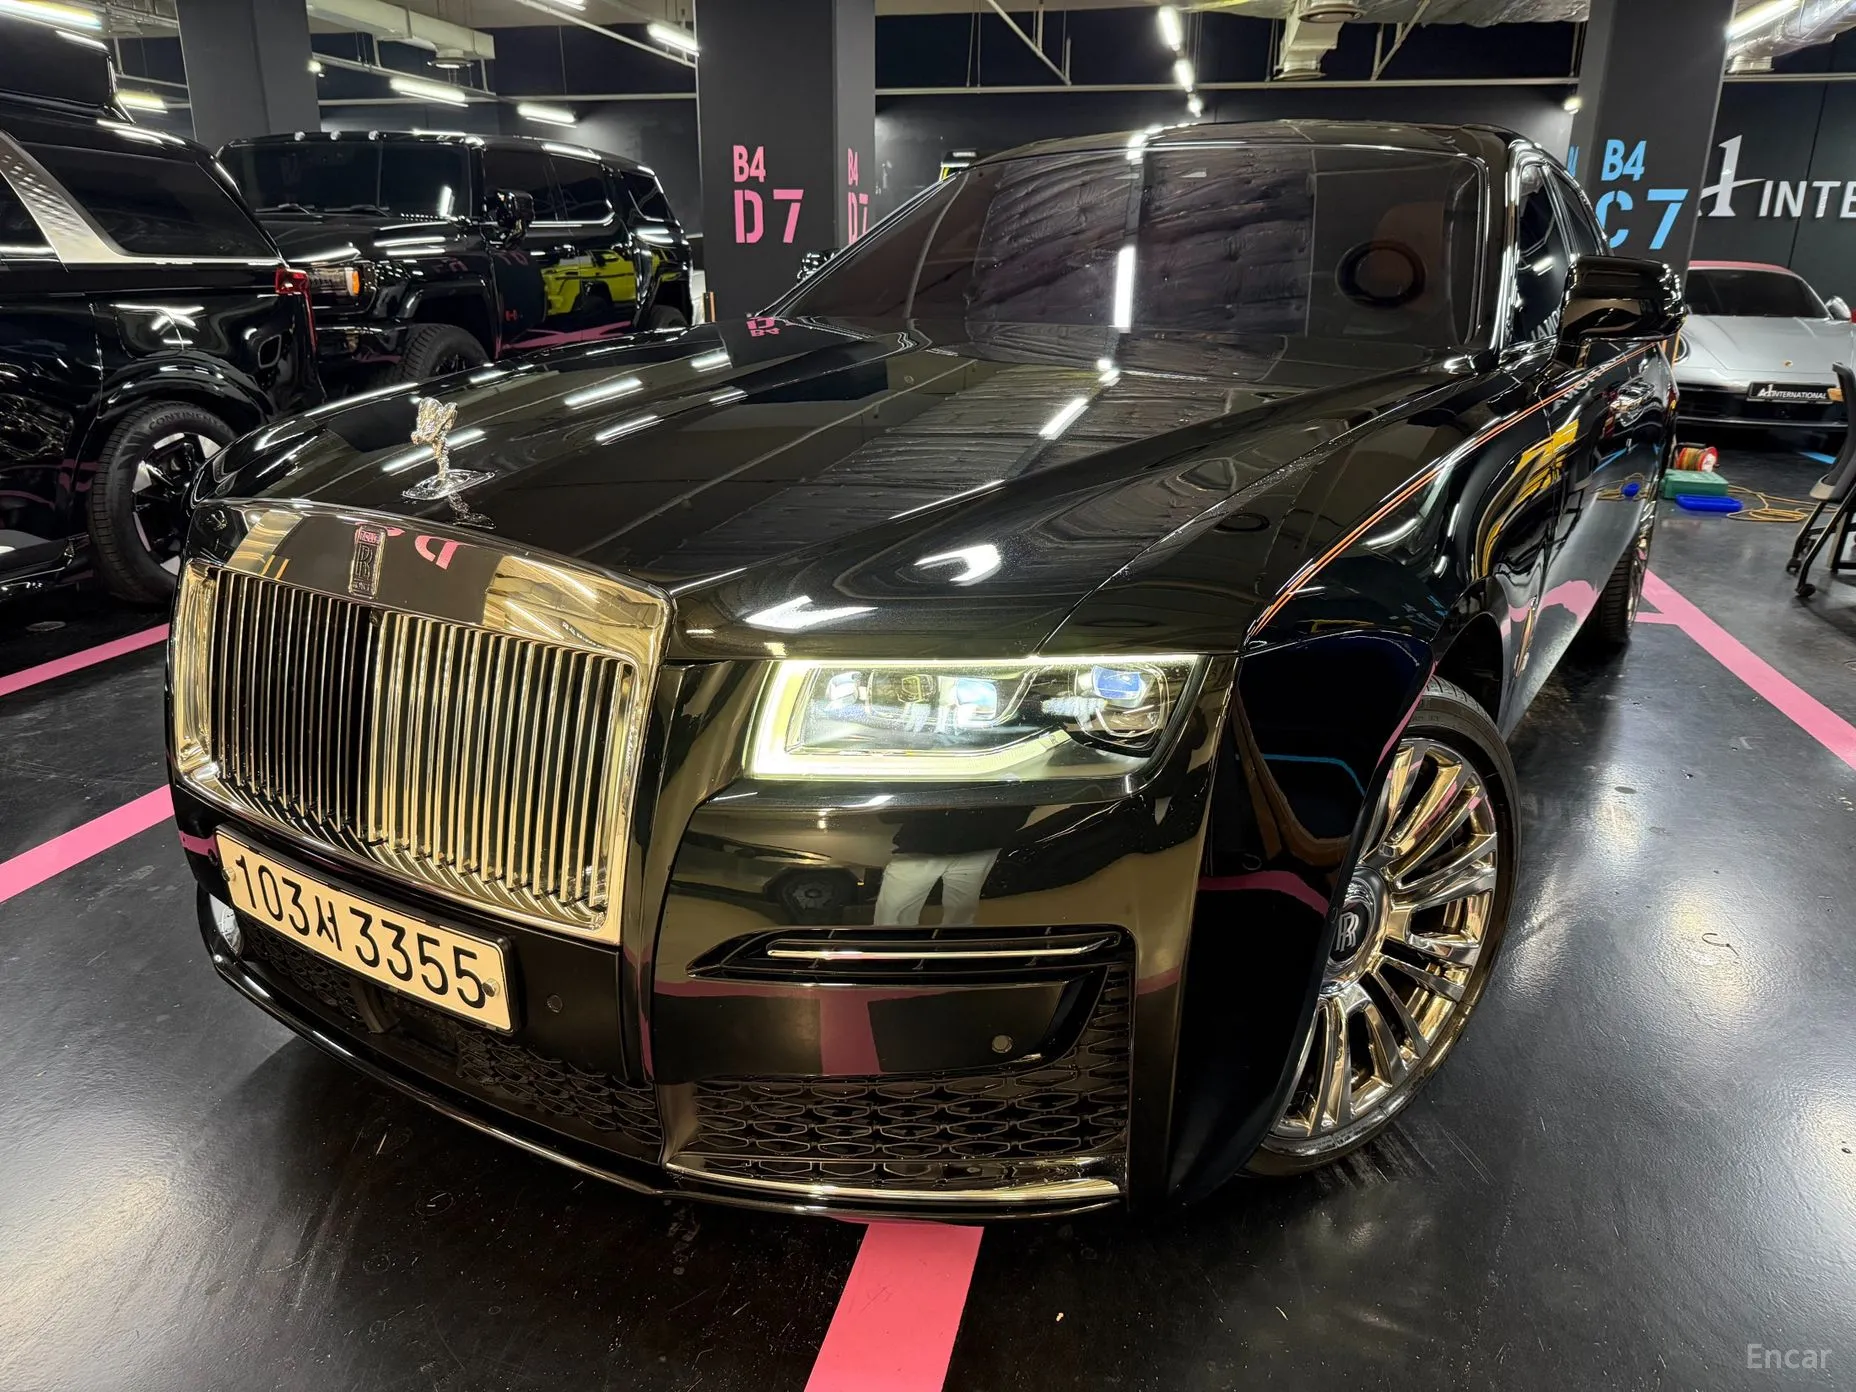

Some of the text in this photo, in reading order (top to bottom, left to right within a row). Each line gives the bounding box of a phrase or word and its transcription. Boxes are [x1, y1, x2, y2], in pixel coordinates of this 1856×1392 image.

[733, 144, 766, 183] B4
[848, 147, 859, 186] B4
[1601, 139, 1647, 182] B4
[1759, 180, 1856, 218] INTE
[235, 854, 488, 1010] 103서 3355
